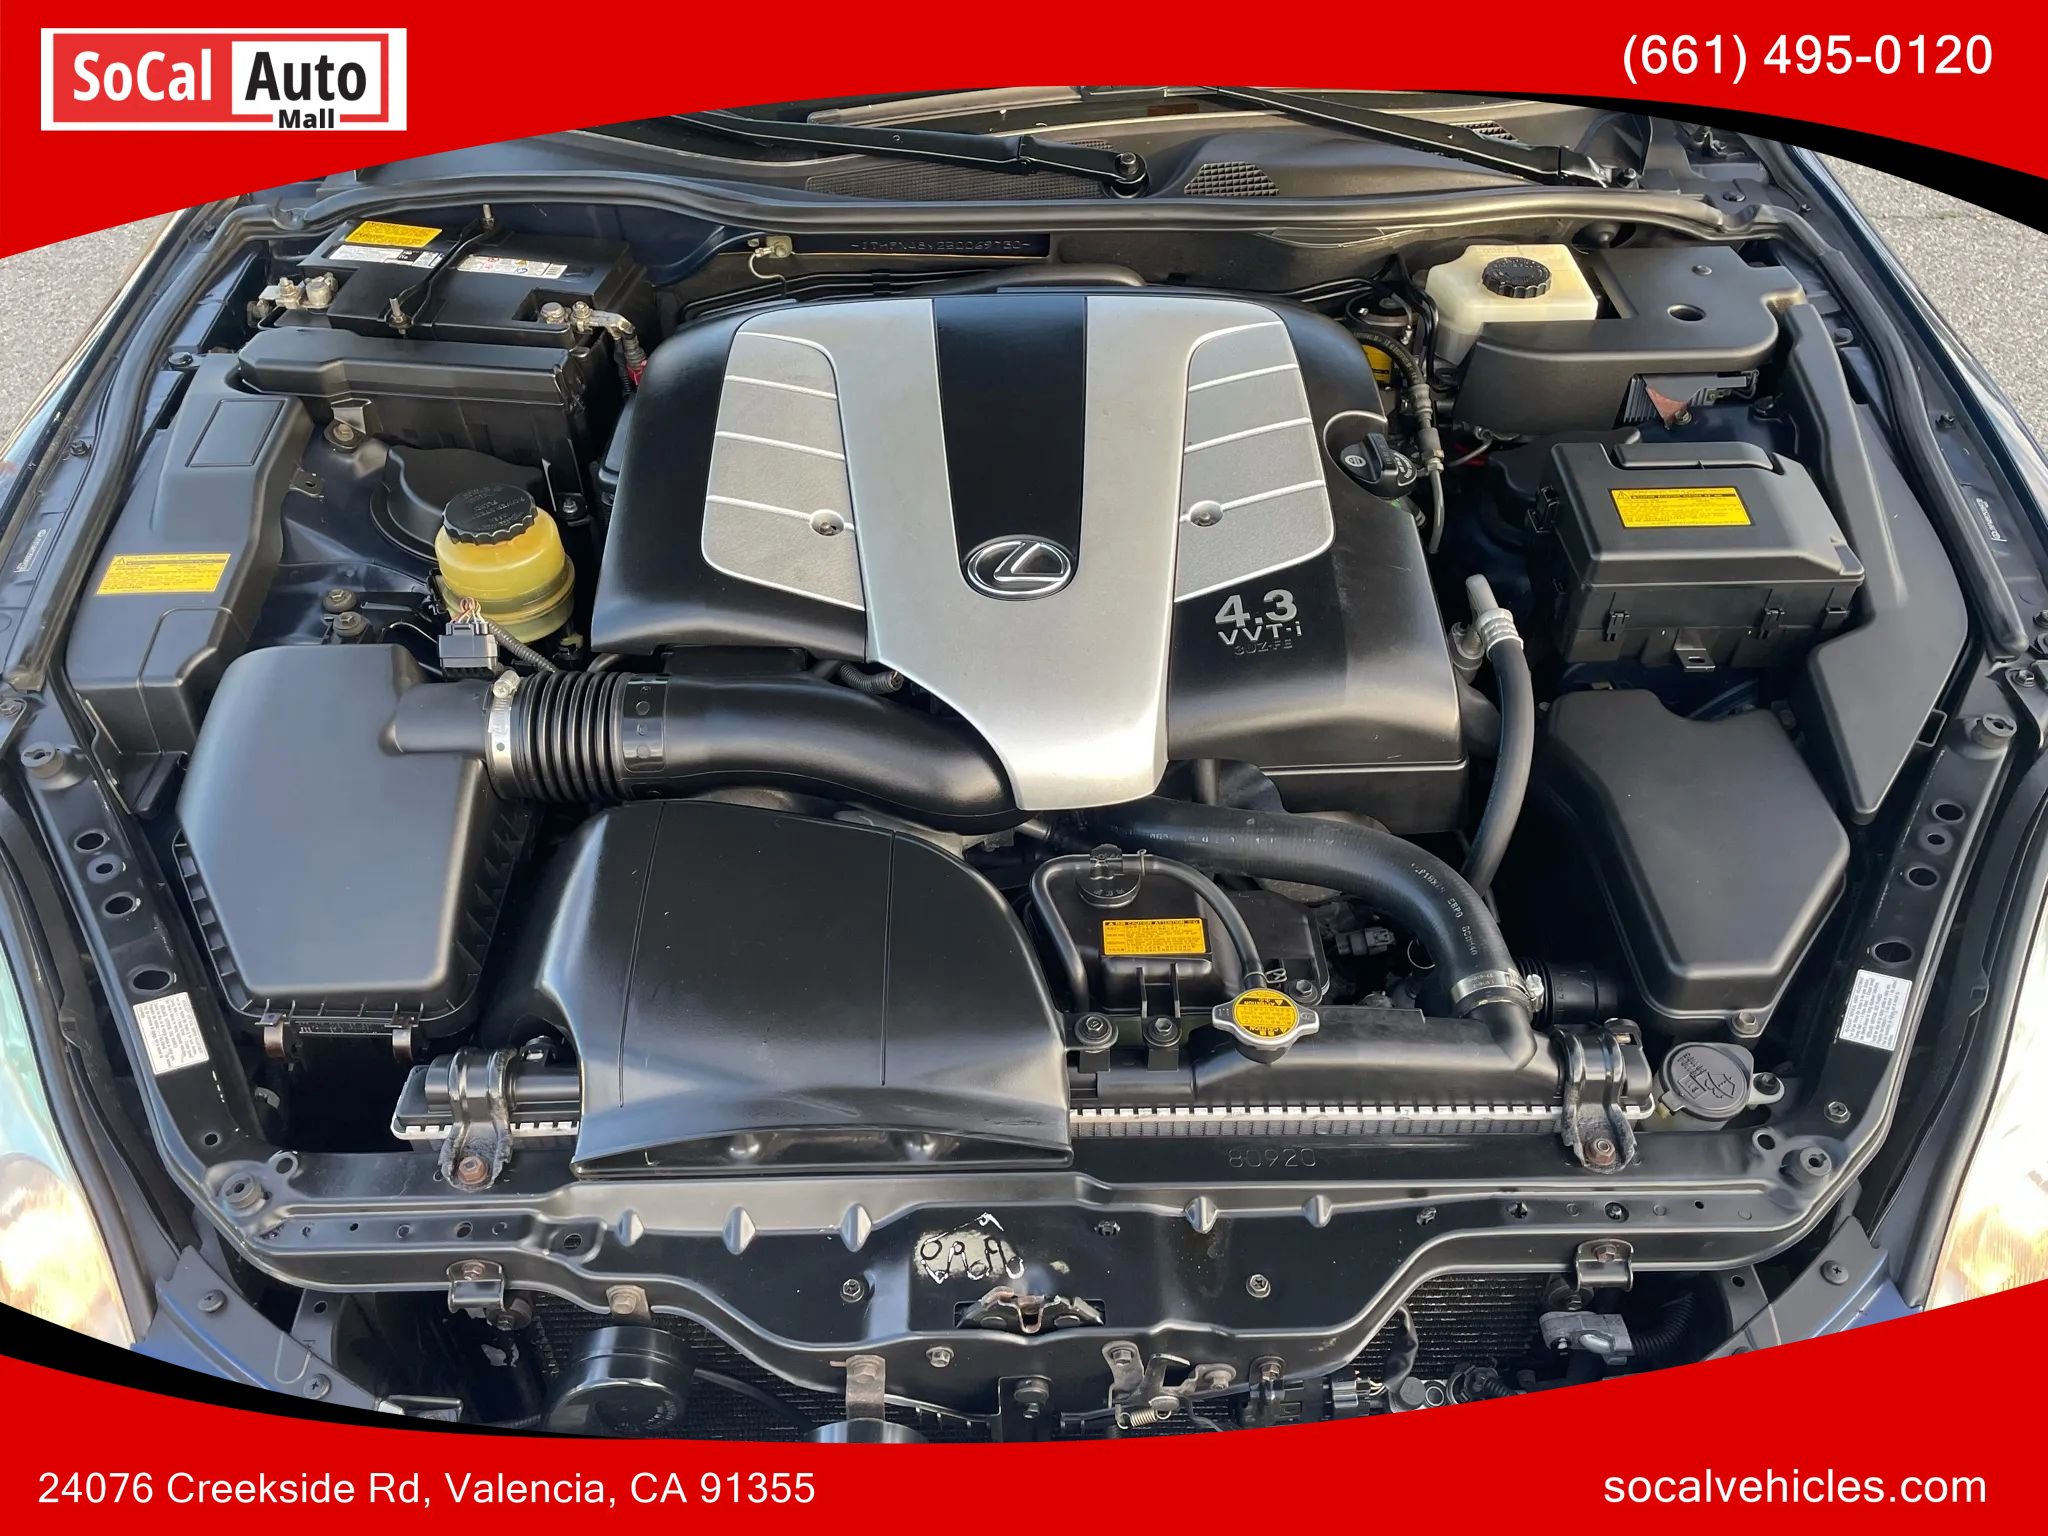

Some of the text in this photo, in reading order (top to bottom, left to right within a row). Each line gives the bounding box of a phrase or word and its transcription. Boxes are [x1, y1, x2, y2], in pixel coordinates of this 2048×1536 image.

[1214, 589, 1298, 628] 4.3
[1217, 621, 1303, 645] VVT-i
[1228, 1148, 1317, 1169] 80920
